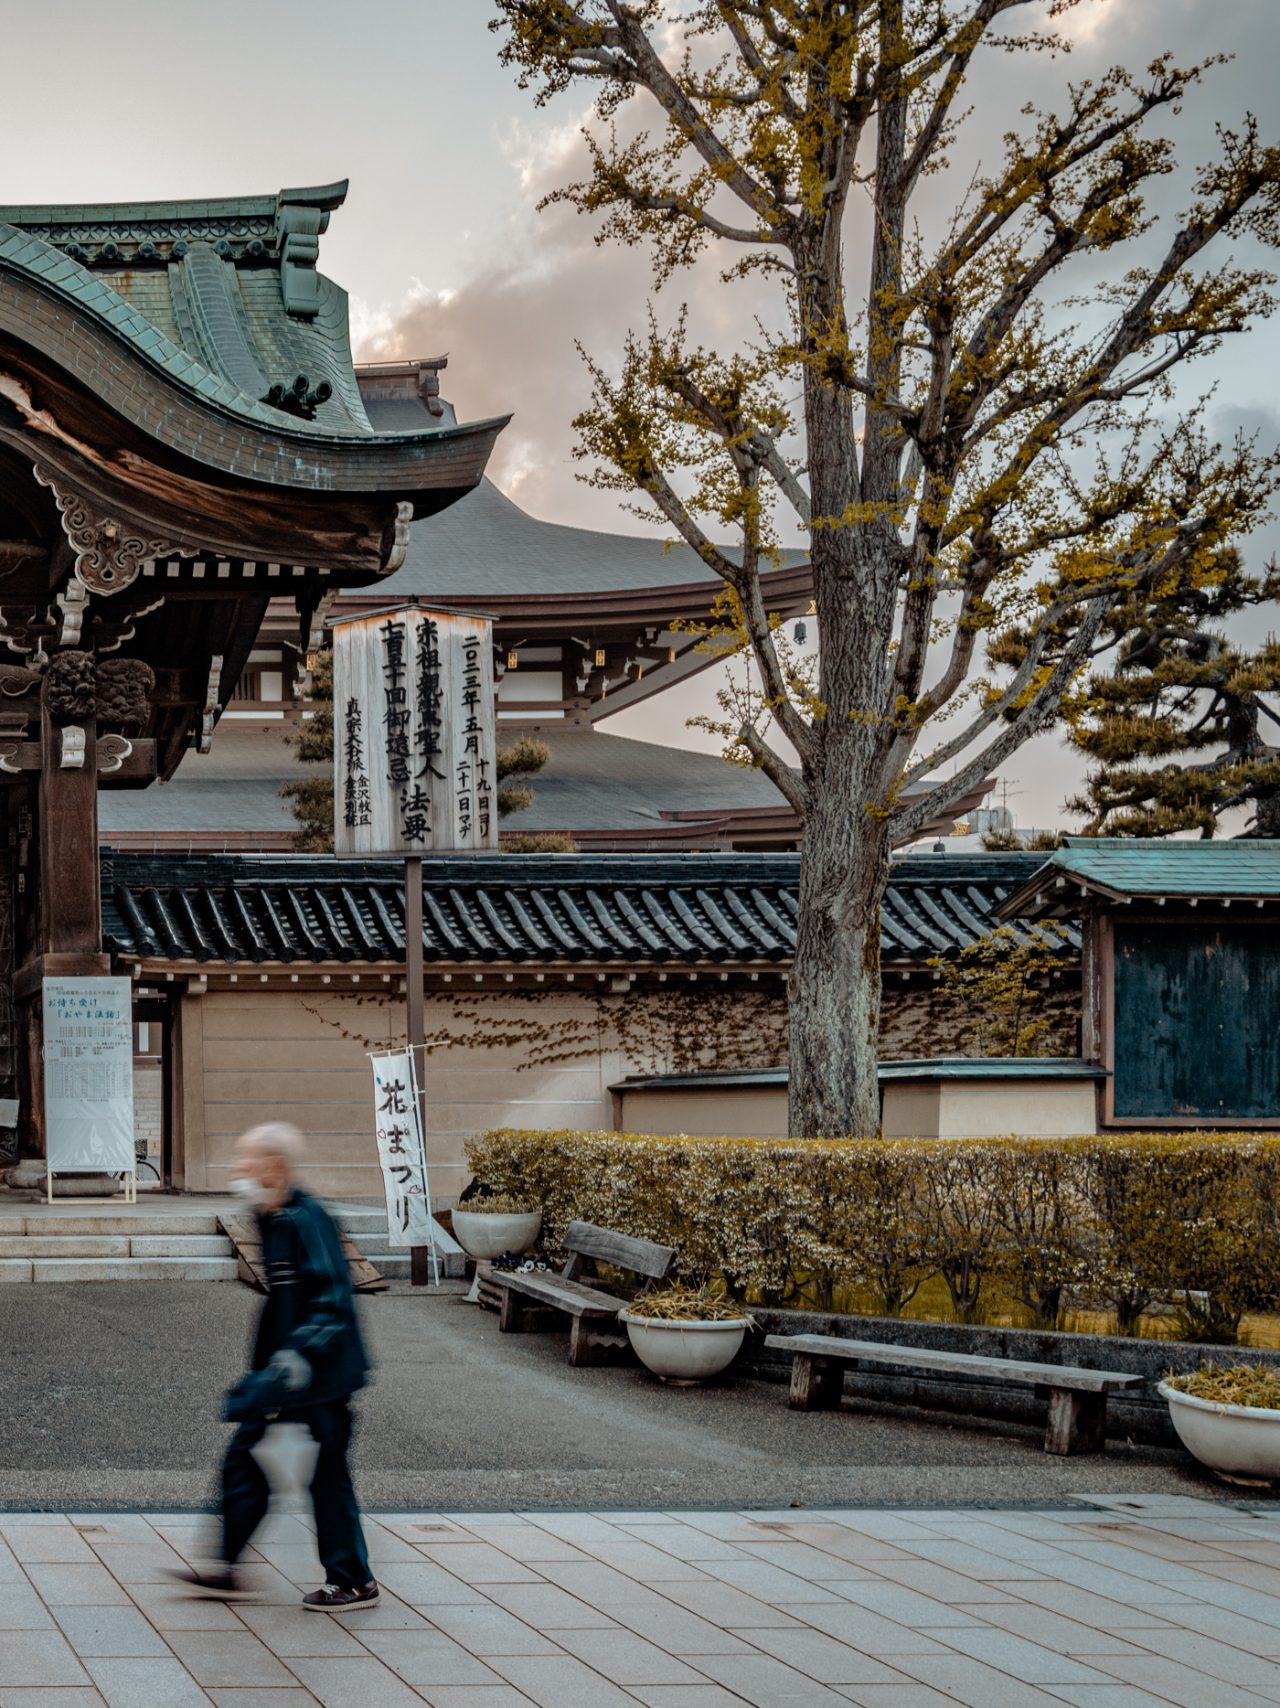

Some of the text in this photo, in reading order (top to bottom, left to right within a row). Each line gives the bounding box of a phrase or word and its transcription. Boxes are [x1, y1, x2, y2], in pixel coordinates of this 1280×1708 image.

[400, 784, 432, 843] 法要
[378, 1079, 413, 1233] 花まつり
